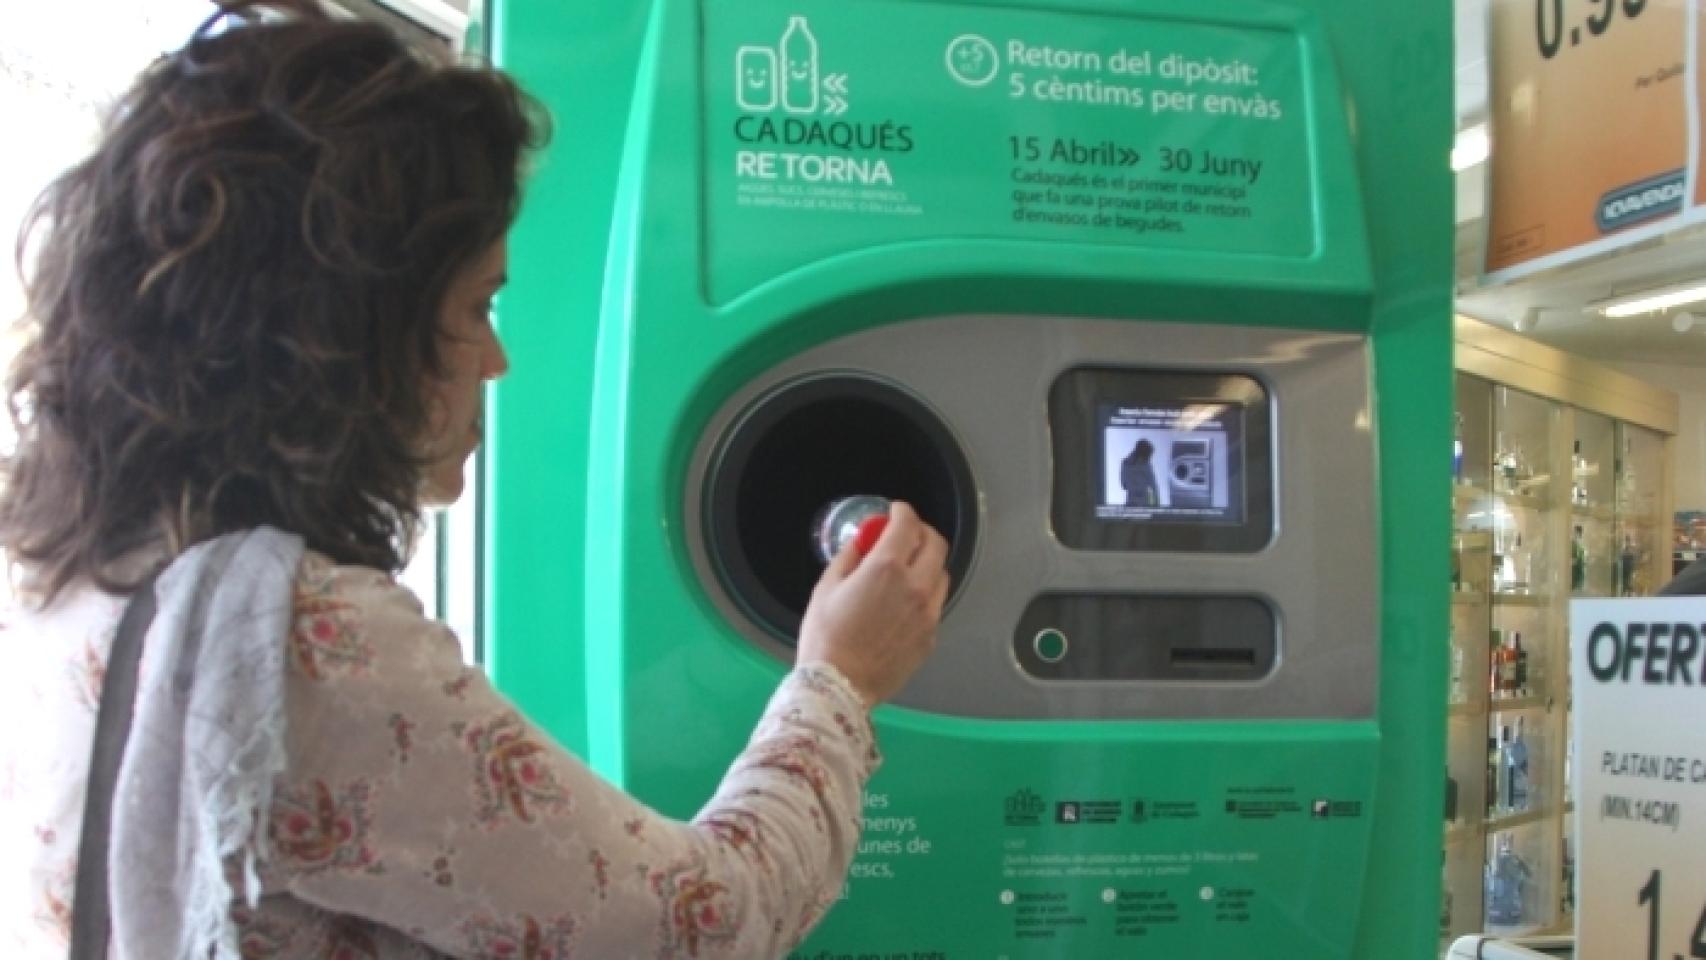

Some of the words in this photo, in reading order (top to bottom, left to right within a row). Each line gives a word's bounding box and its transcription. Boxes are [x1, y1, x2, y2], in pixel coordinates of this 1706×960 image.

[1008, 39, 1101, 70] Retorn
[1109, 49, 1151, 76] del
[1159, 54, 1259, 86] dipòsit:
[1009, 73, 1026, 98] 5
[1033, 75, 1145, 108] cèntims
[1152, 89, 1197, 114] per
[1203, 92, 1282, 119] envàs
[736, 151, 894, 185] RETORNA
[1009, 136, 1041, 162] 15
[1159, 146, 1193, 173] 30
[1200, 150, 1262, 183] Juny
[1601, 751, 1661, 778] PLATAN
[1663, 757, 1686, 783] DE
[861, 791, 889, 808] les
[857, 838, 902, 854] unes
[906, 835, 931, 854] de
